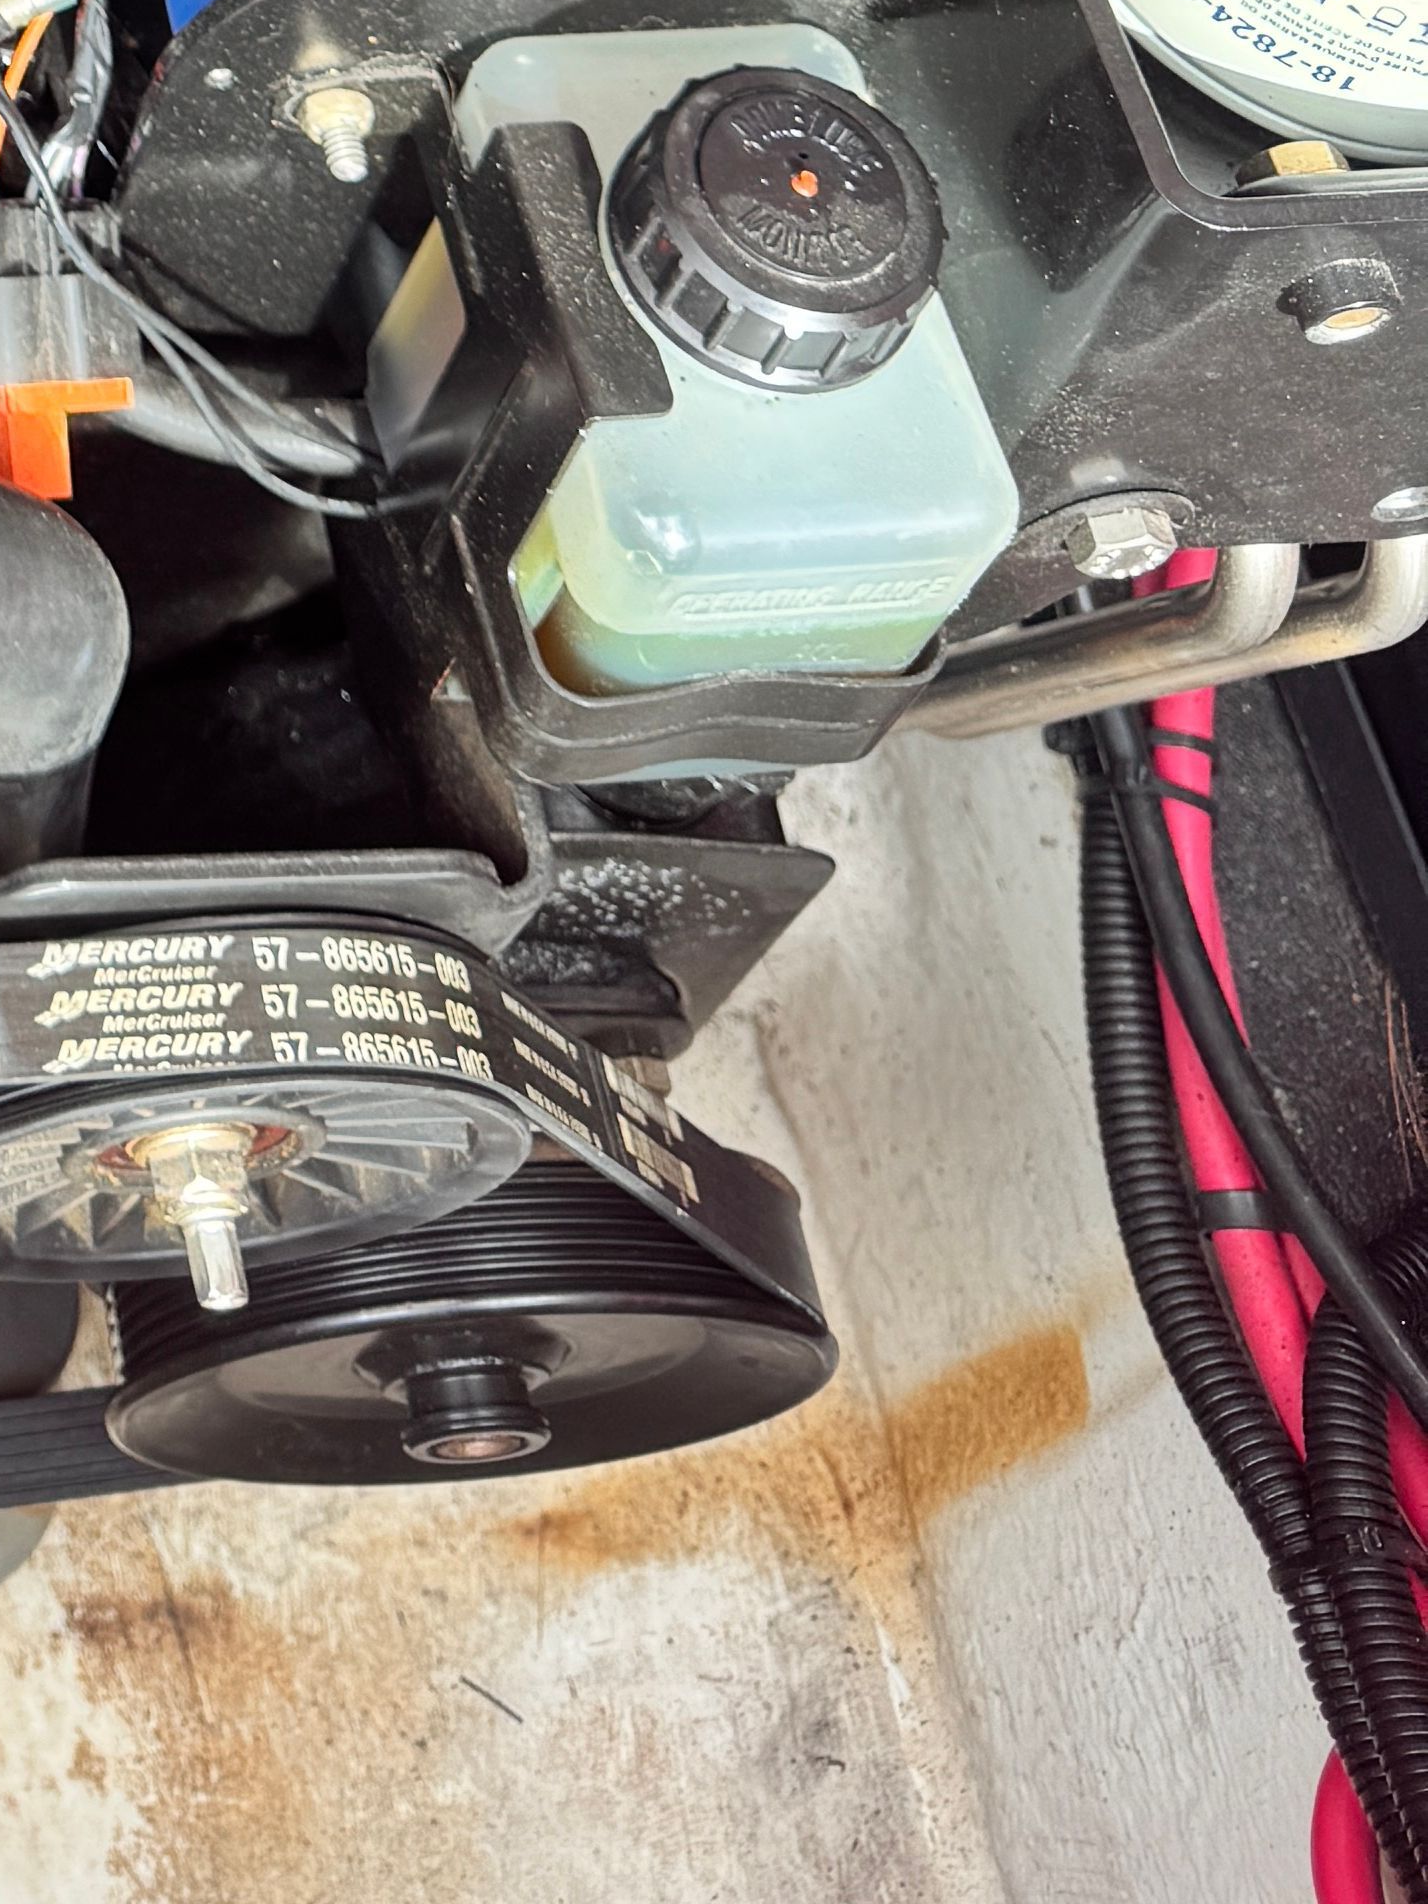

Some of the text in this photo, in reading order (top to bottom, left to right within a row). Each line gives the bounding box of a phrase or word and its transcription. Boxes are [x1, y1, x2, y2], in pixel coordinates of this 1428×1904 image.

[30, 935, 235, 976] MERCURY
[94, 963, 219, 986] MerCruiser
[37, 982, 244, 1024] MERCURY
[102, 1010, 227, 1033] MerCruiser
[44, 1030, 253, 1073] MERCURY
